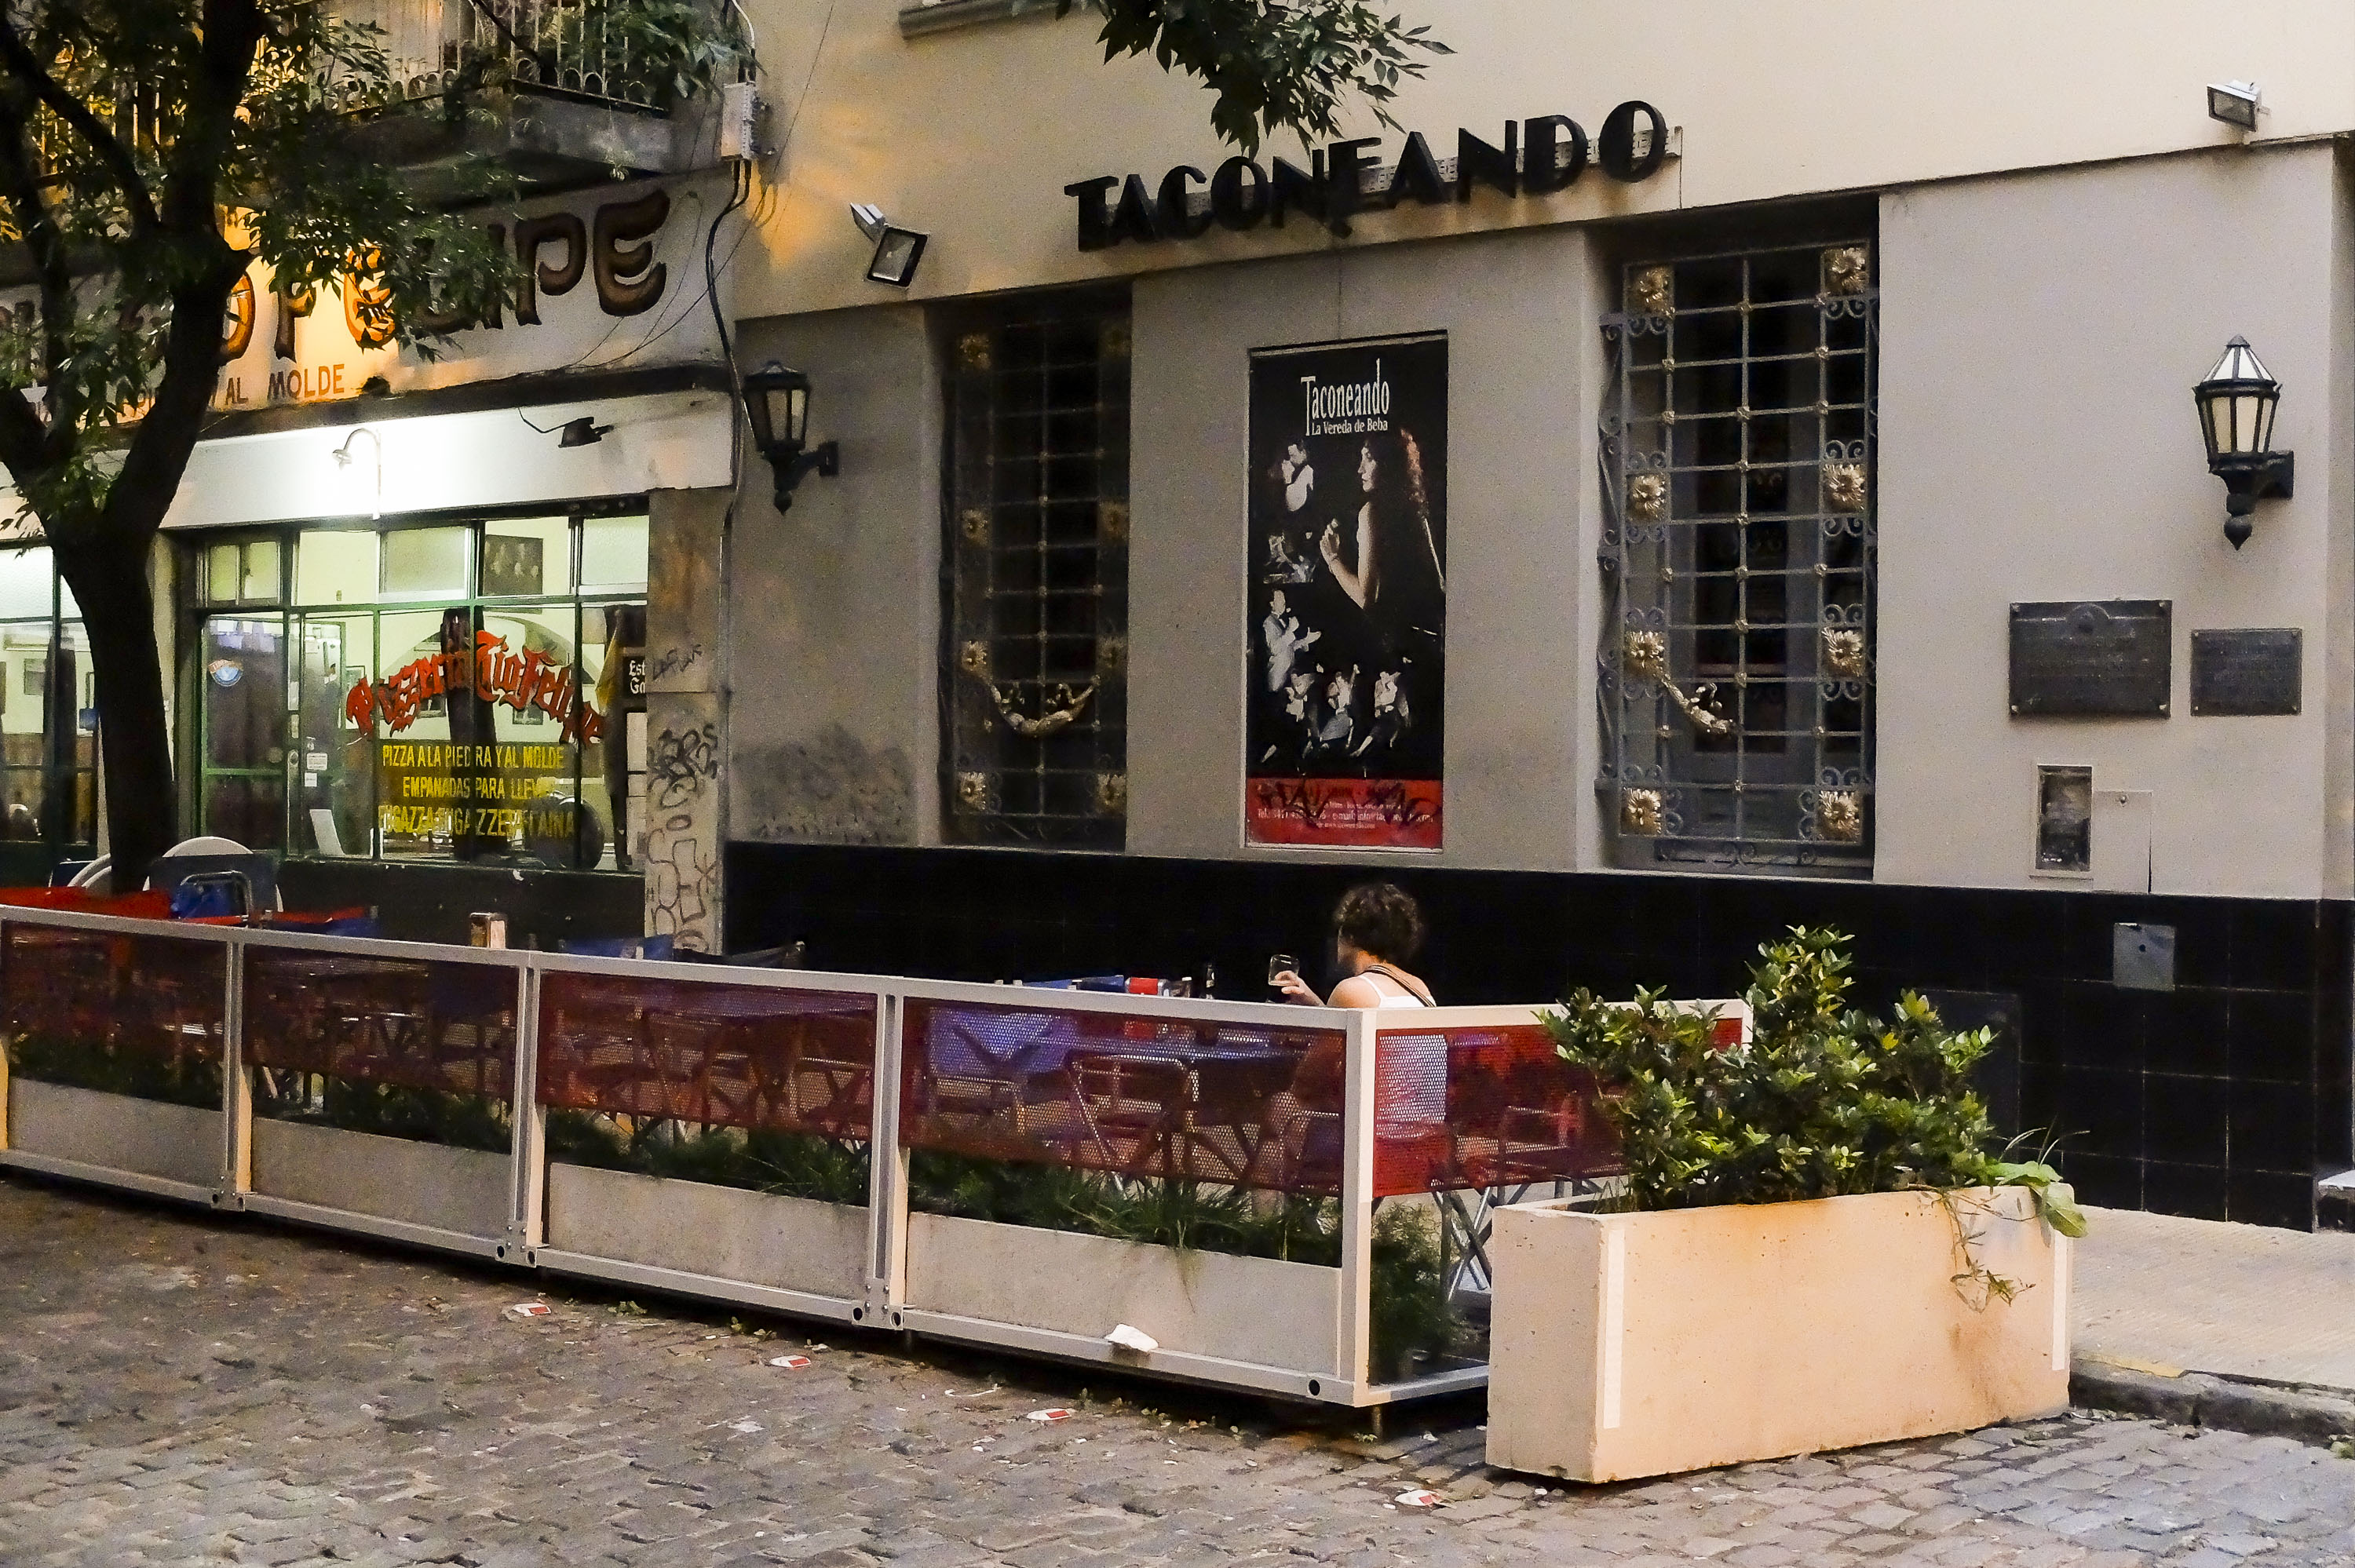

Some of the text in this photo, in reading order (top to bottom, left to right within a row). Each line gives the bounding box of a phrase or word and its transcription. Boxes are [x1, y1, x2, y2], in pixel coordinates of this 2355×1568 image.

[1064, 100, 1667, 251] TACONEANDO
[225, 377, 248, 406] AL
[267, 363, 345, 401] MOLDE
[1301, 358, 1390, 436] Taconeando
[1311, 417, 1389, 436] La Vereda de Beba
[382, 745, 415, 768] PIZZA
[417, 746, 426, 768] A
[427, 746, 441, 768] LA
[445, 745, 492, 768] PIEDRA
[523, 746, 565, 769] MOLDE
[403, 776, 470, 798] EMPANADAS
[475, 777, 506, 799] PARA
